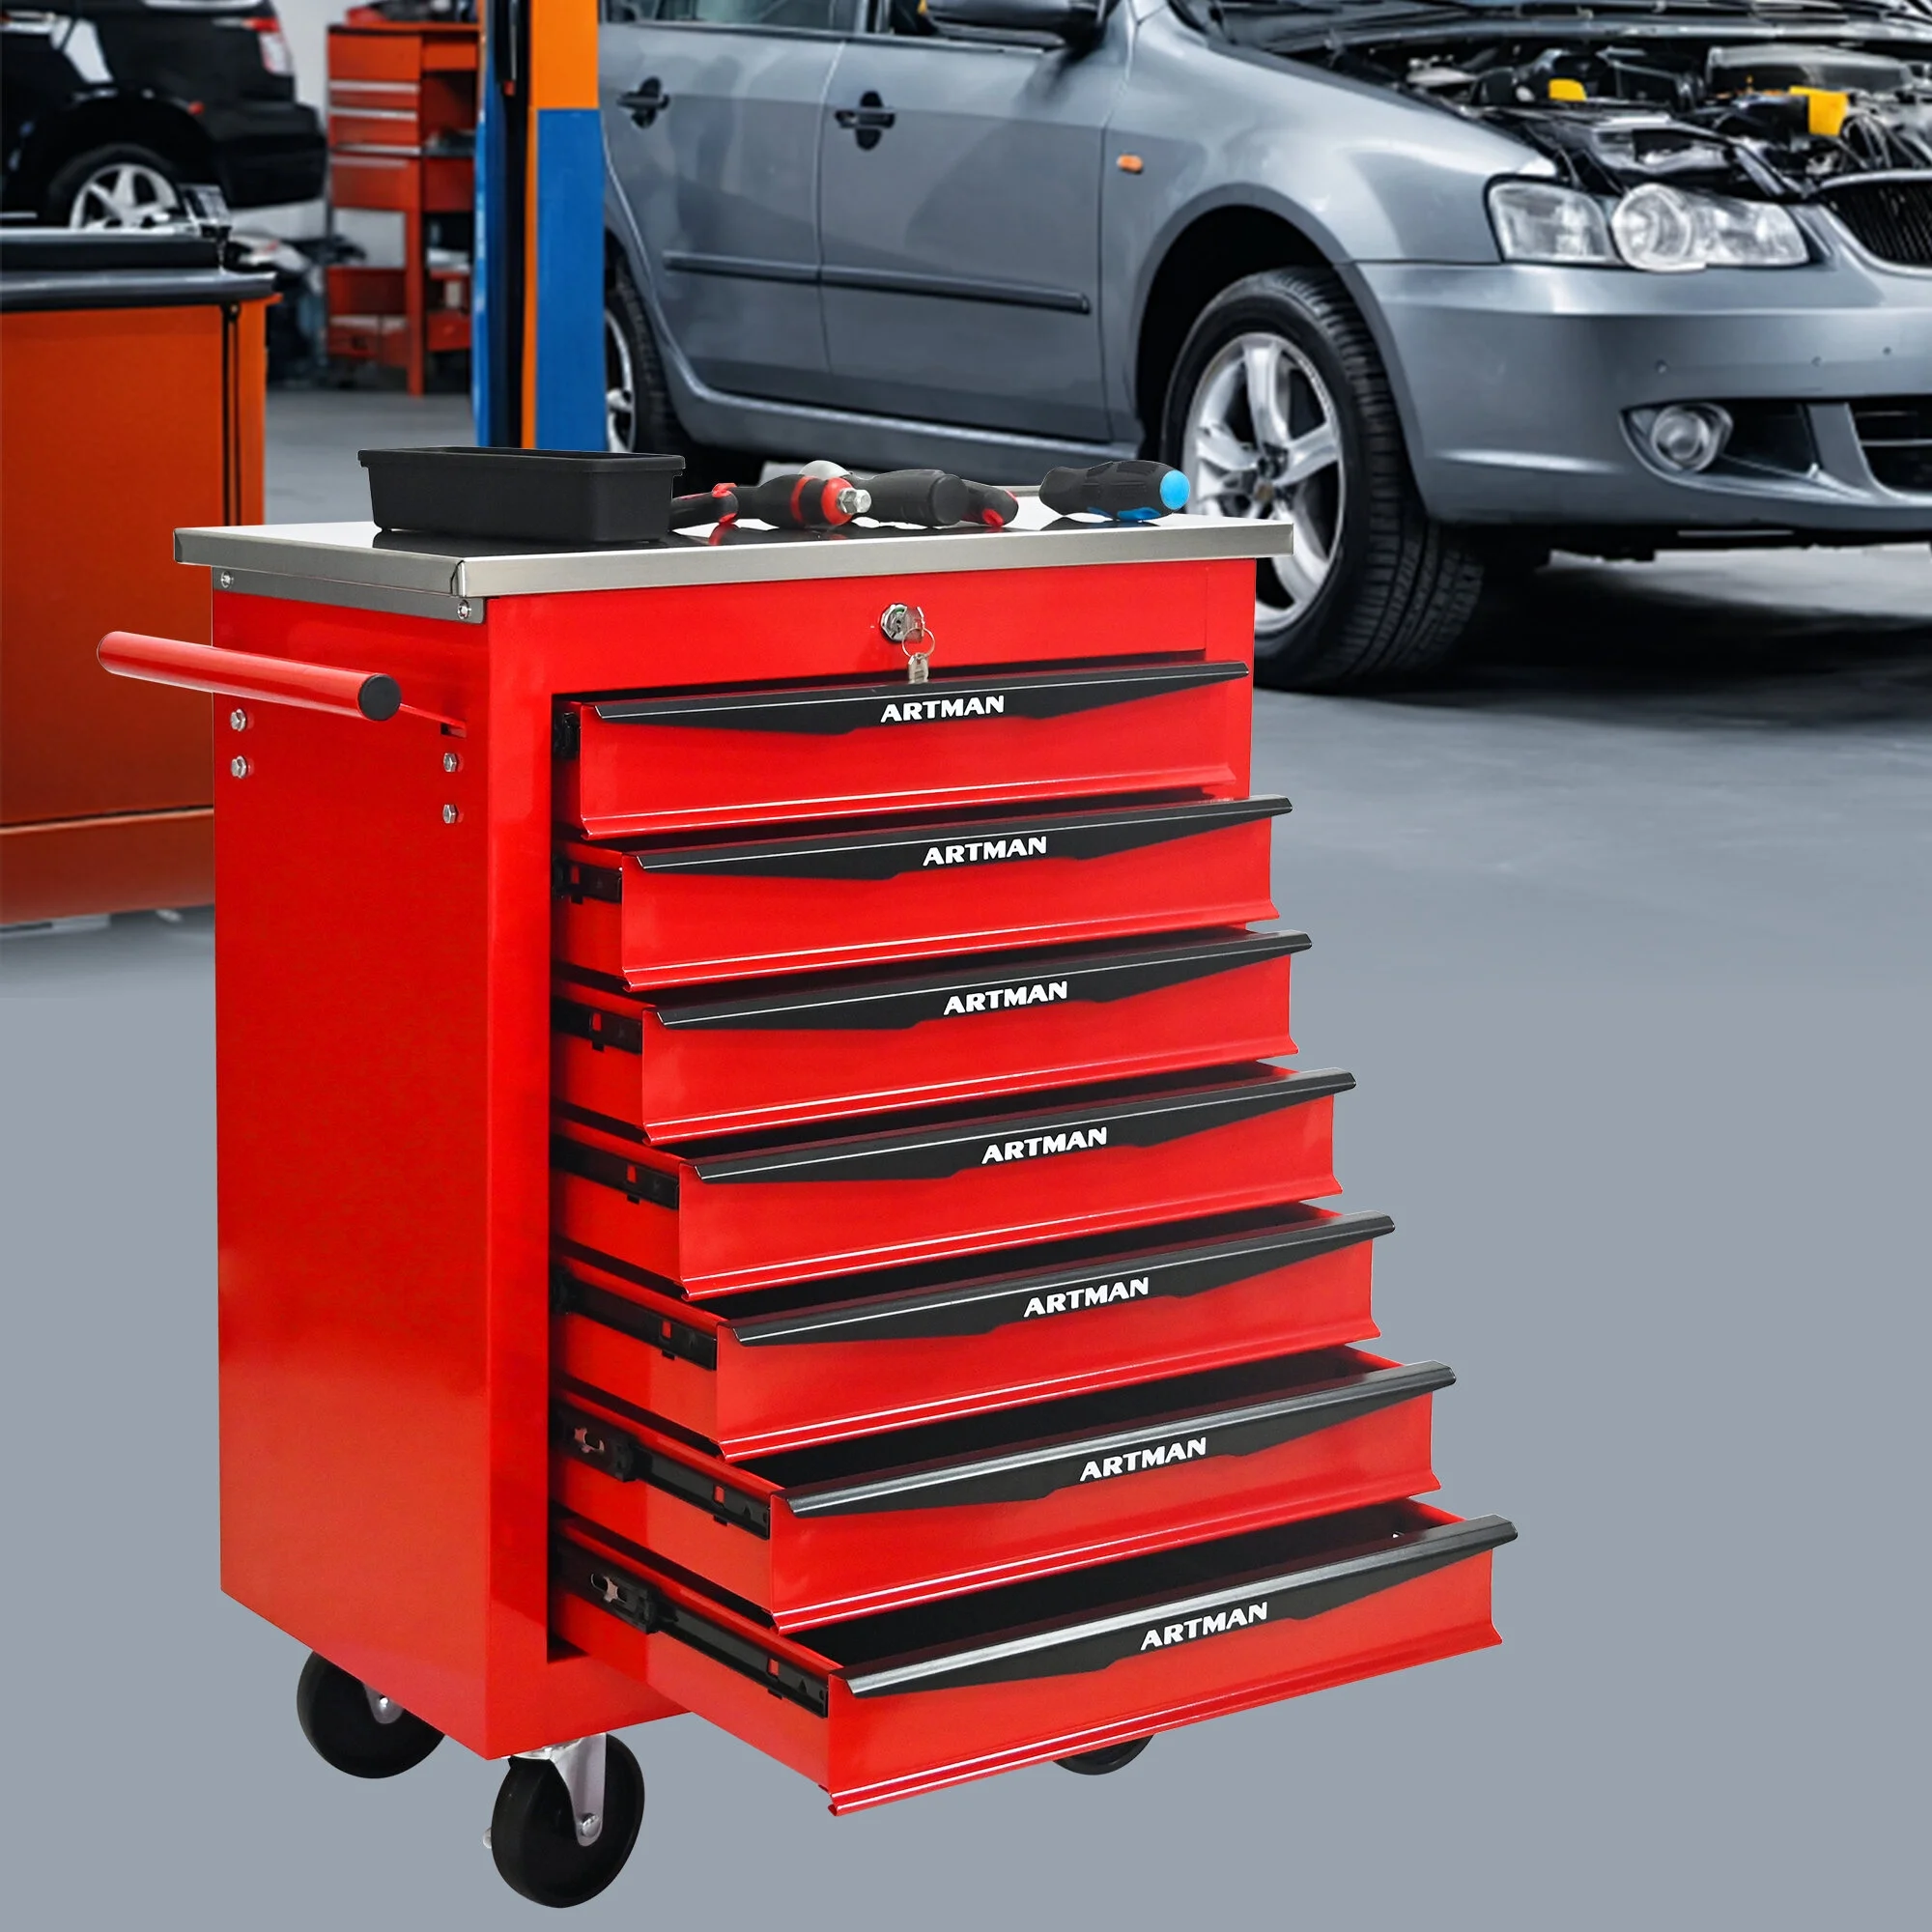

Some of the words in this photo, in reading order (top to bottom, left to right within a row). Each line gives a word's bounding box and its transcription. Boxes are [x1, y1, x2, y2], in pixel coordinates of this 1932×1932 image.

[881, 696, 1005, 723] ARTMAN
[923, 837, 1047, 866] ARTMAN
[944, 981, 1067, 1015] ARTMAN
[981, 1127, 1107, 1164] ARTMAN
[1024, 1277, 1149, 1317] ARTMAN
[1080, 1437, 1207, 1481] ARTMAN
[1141, 1602, 1267, 1650] ARTMAN
